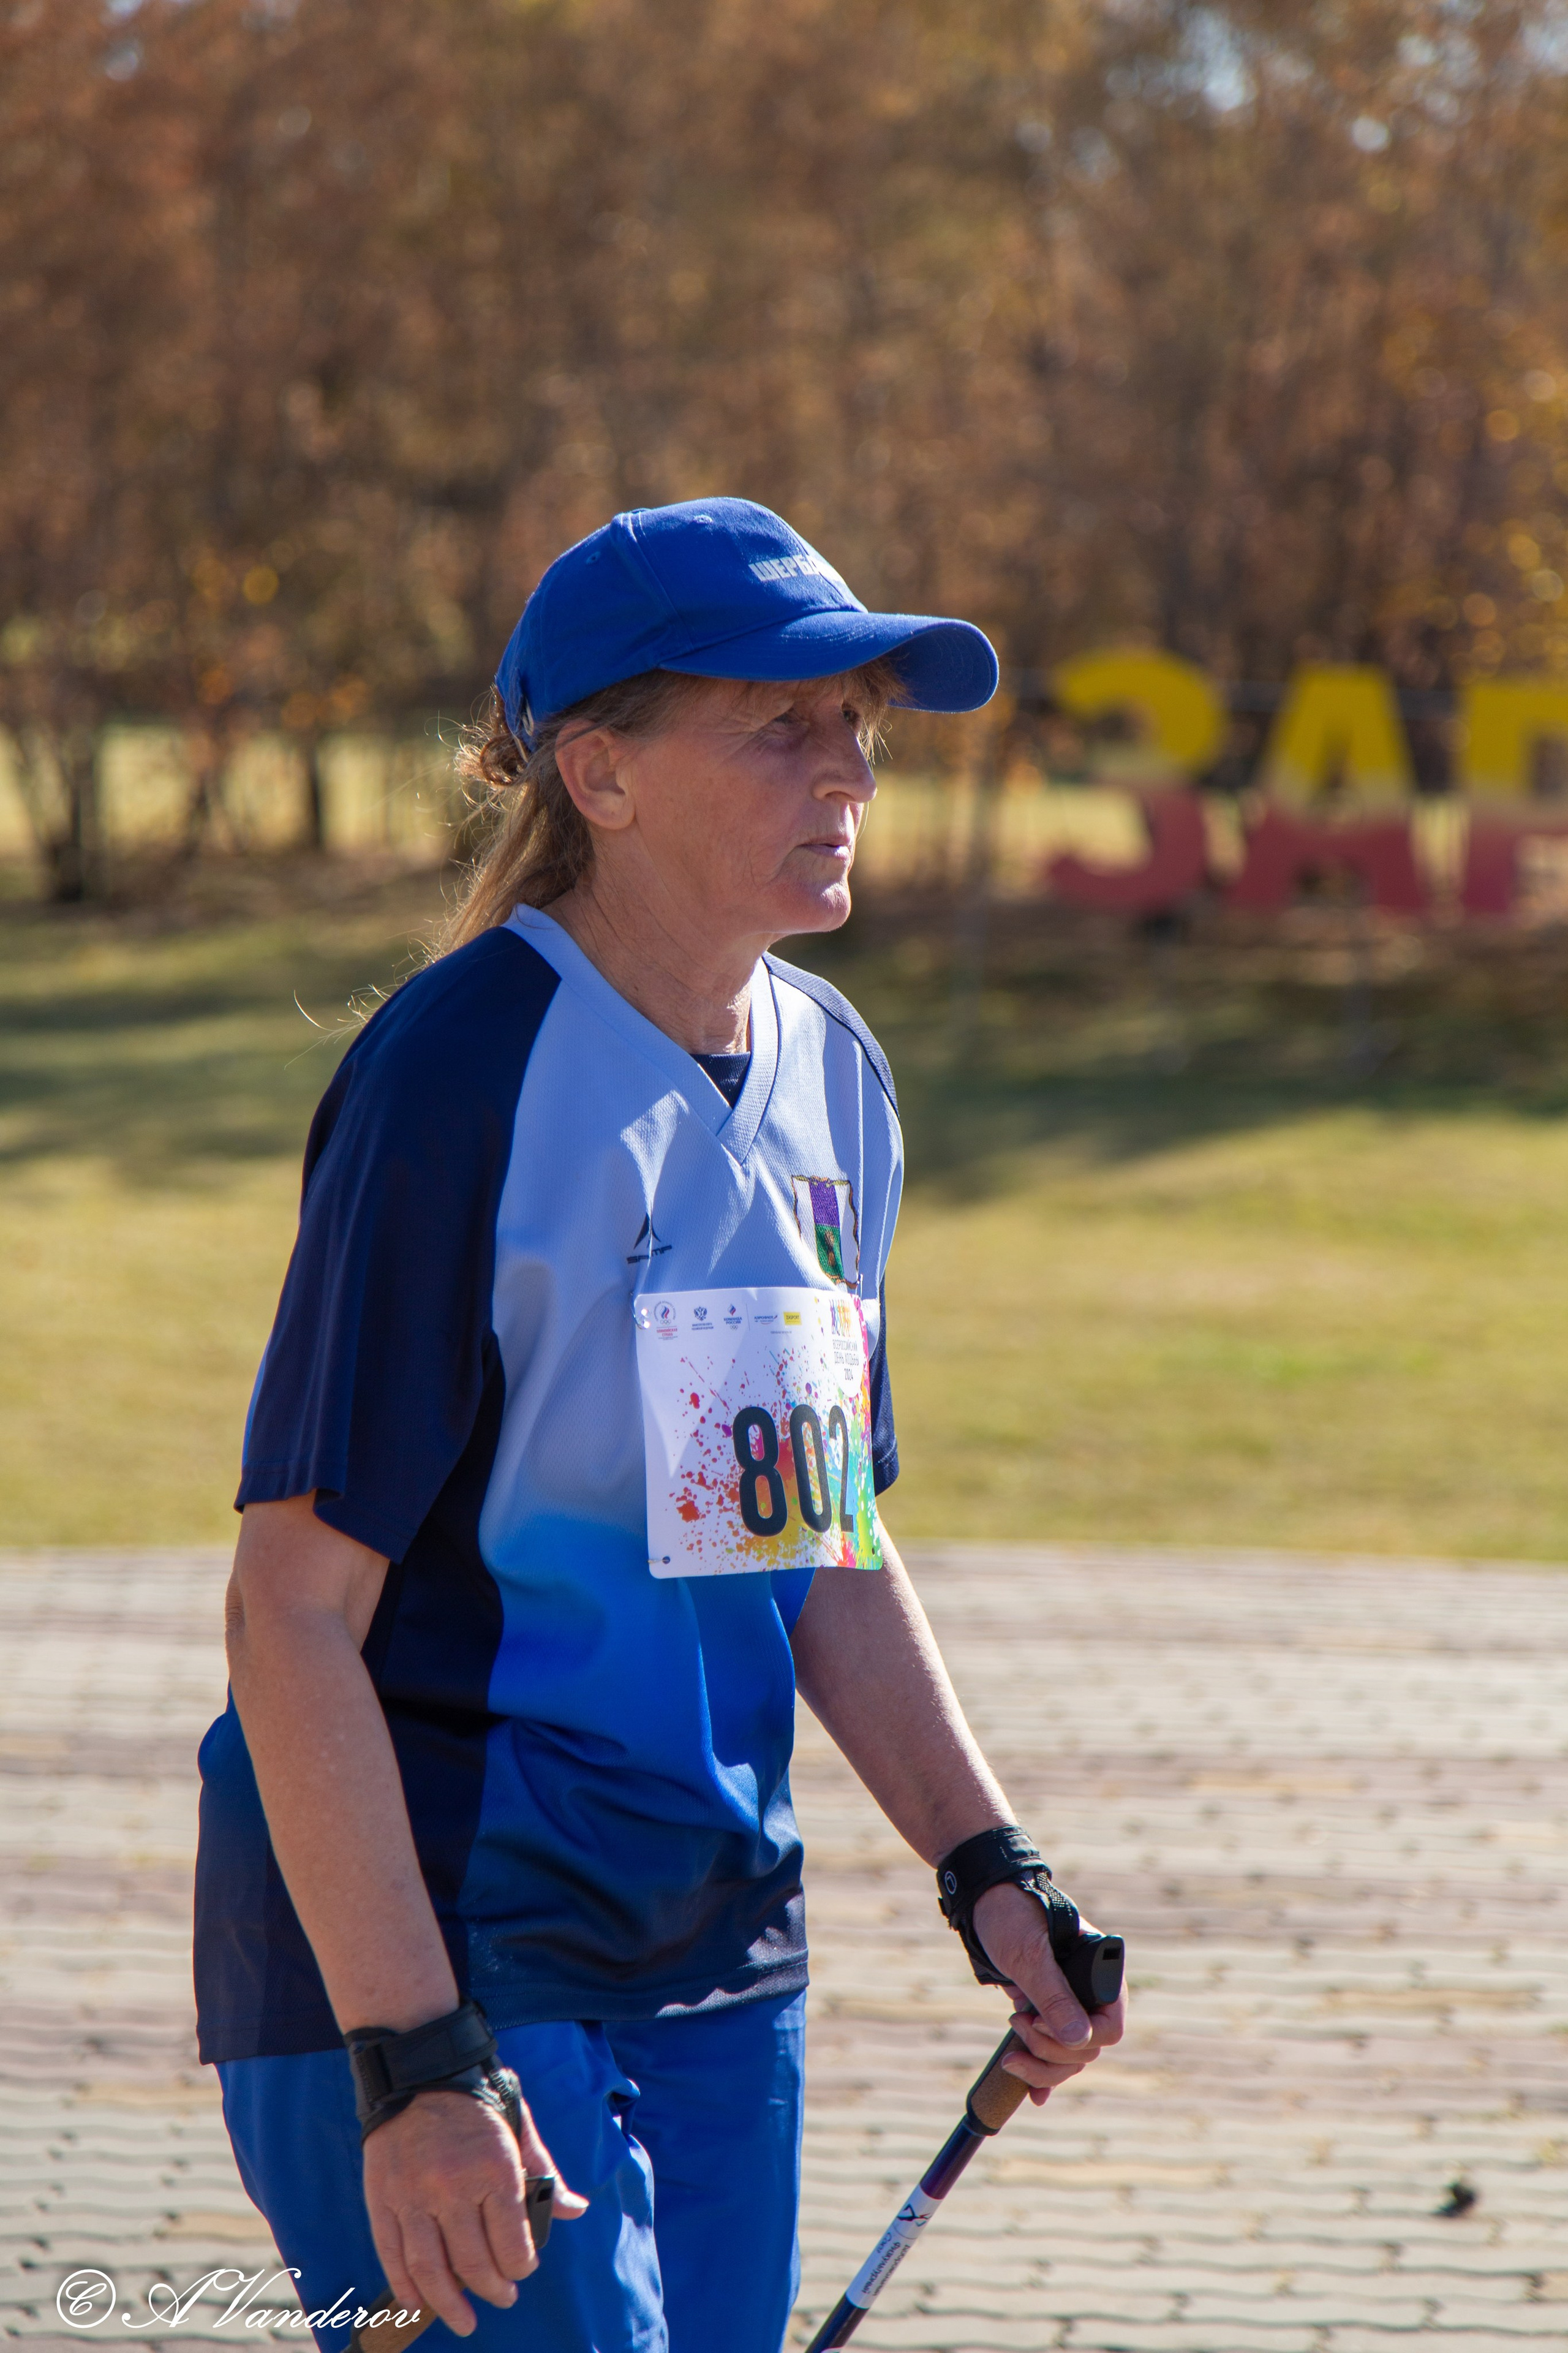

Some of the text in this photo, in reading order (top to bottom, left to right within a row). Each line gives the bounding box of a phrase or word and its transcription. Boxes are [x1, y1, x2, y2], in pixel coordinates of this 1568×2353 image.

[834, 1351, 845, 1365] ДЕНЬ
[844, 1368, 854, 1381] 2024
[733, 1404, 854, 1537] 802
